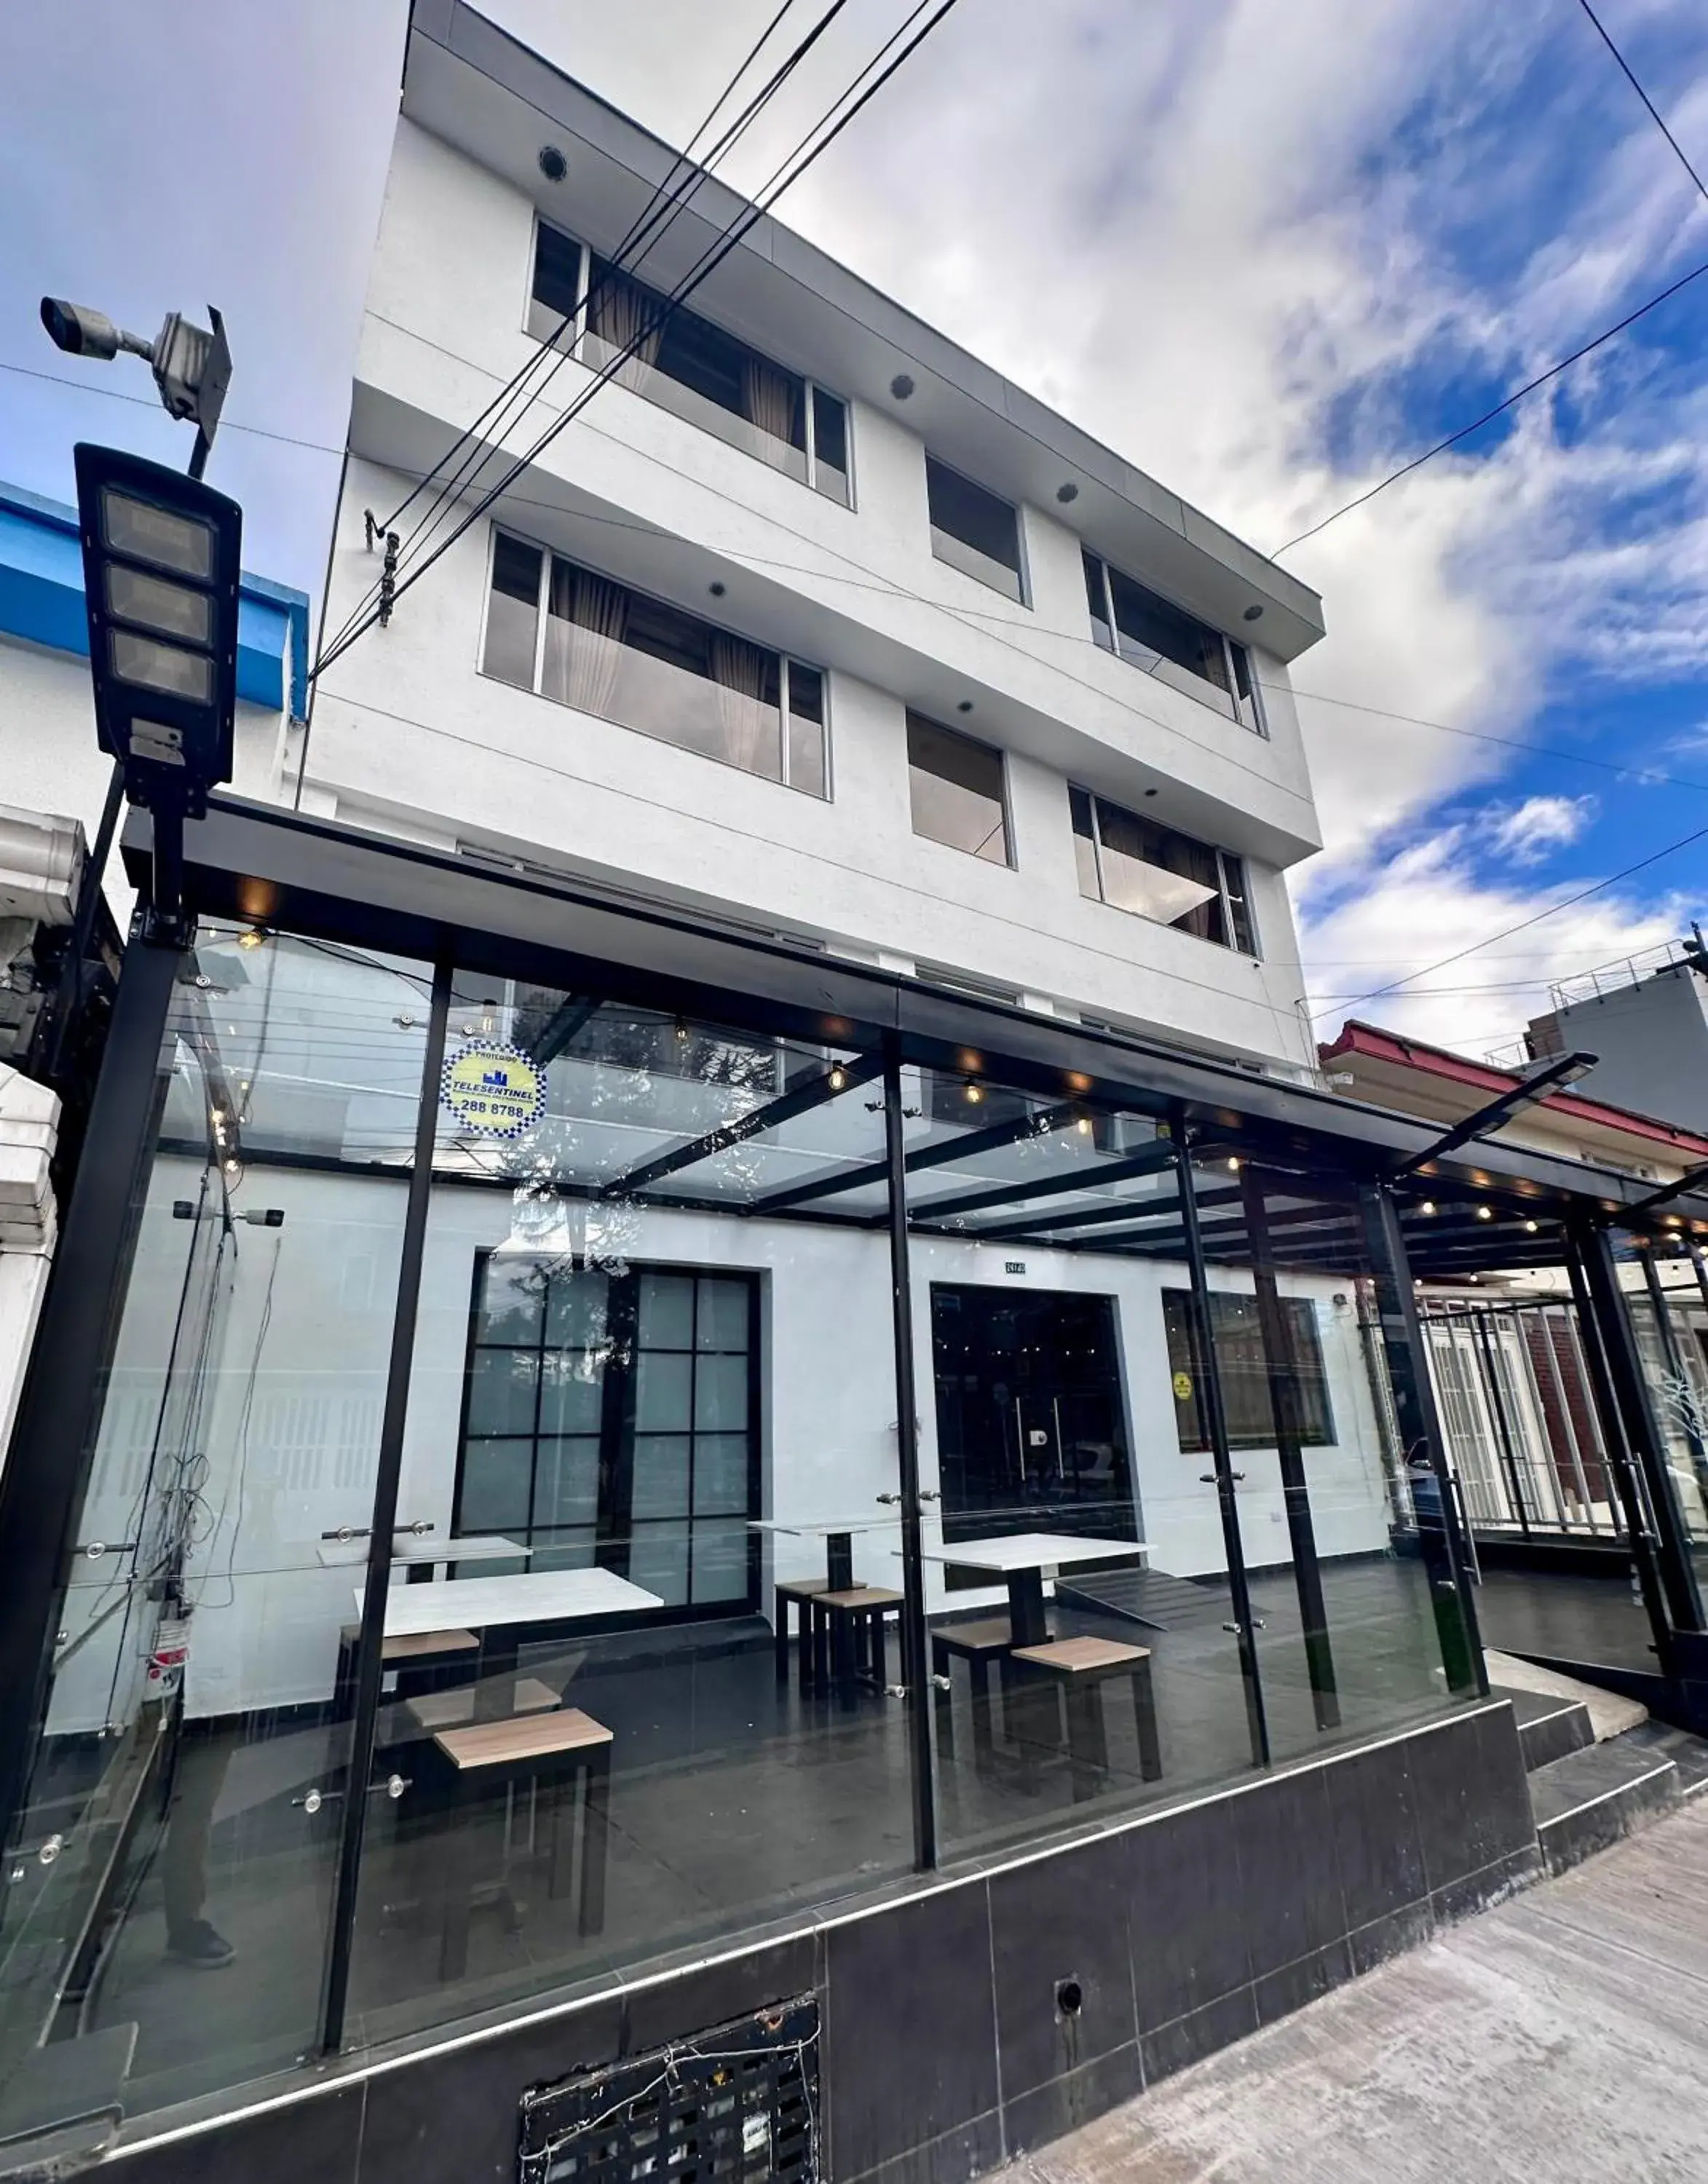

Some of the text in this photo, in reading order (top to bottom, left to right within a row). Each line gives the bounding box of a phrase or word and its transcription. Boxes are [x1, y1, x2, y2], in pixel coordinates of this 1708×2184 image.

[453, 1081, 534, 1100] TELESENTINEL
[461, 1099, 523, 1117] 288 8788
